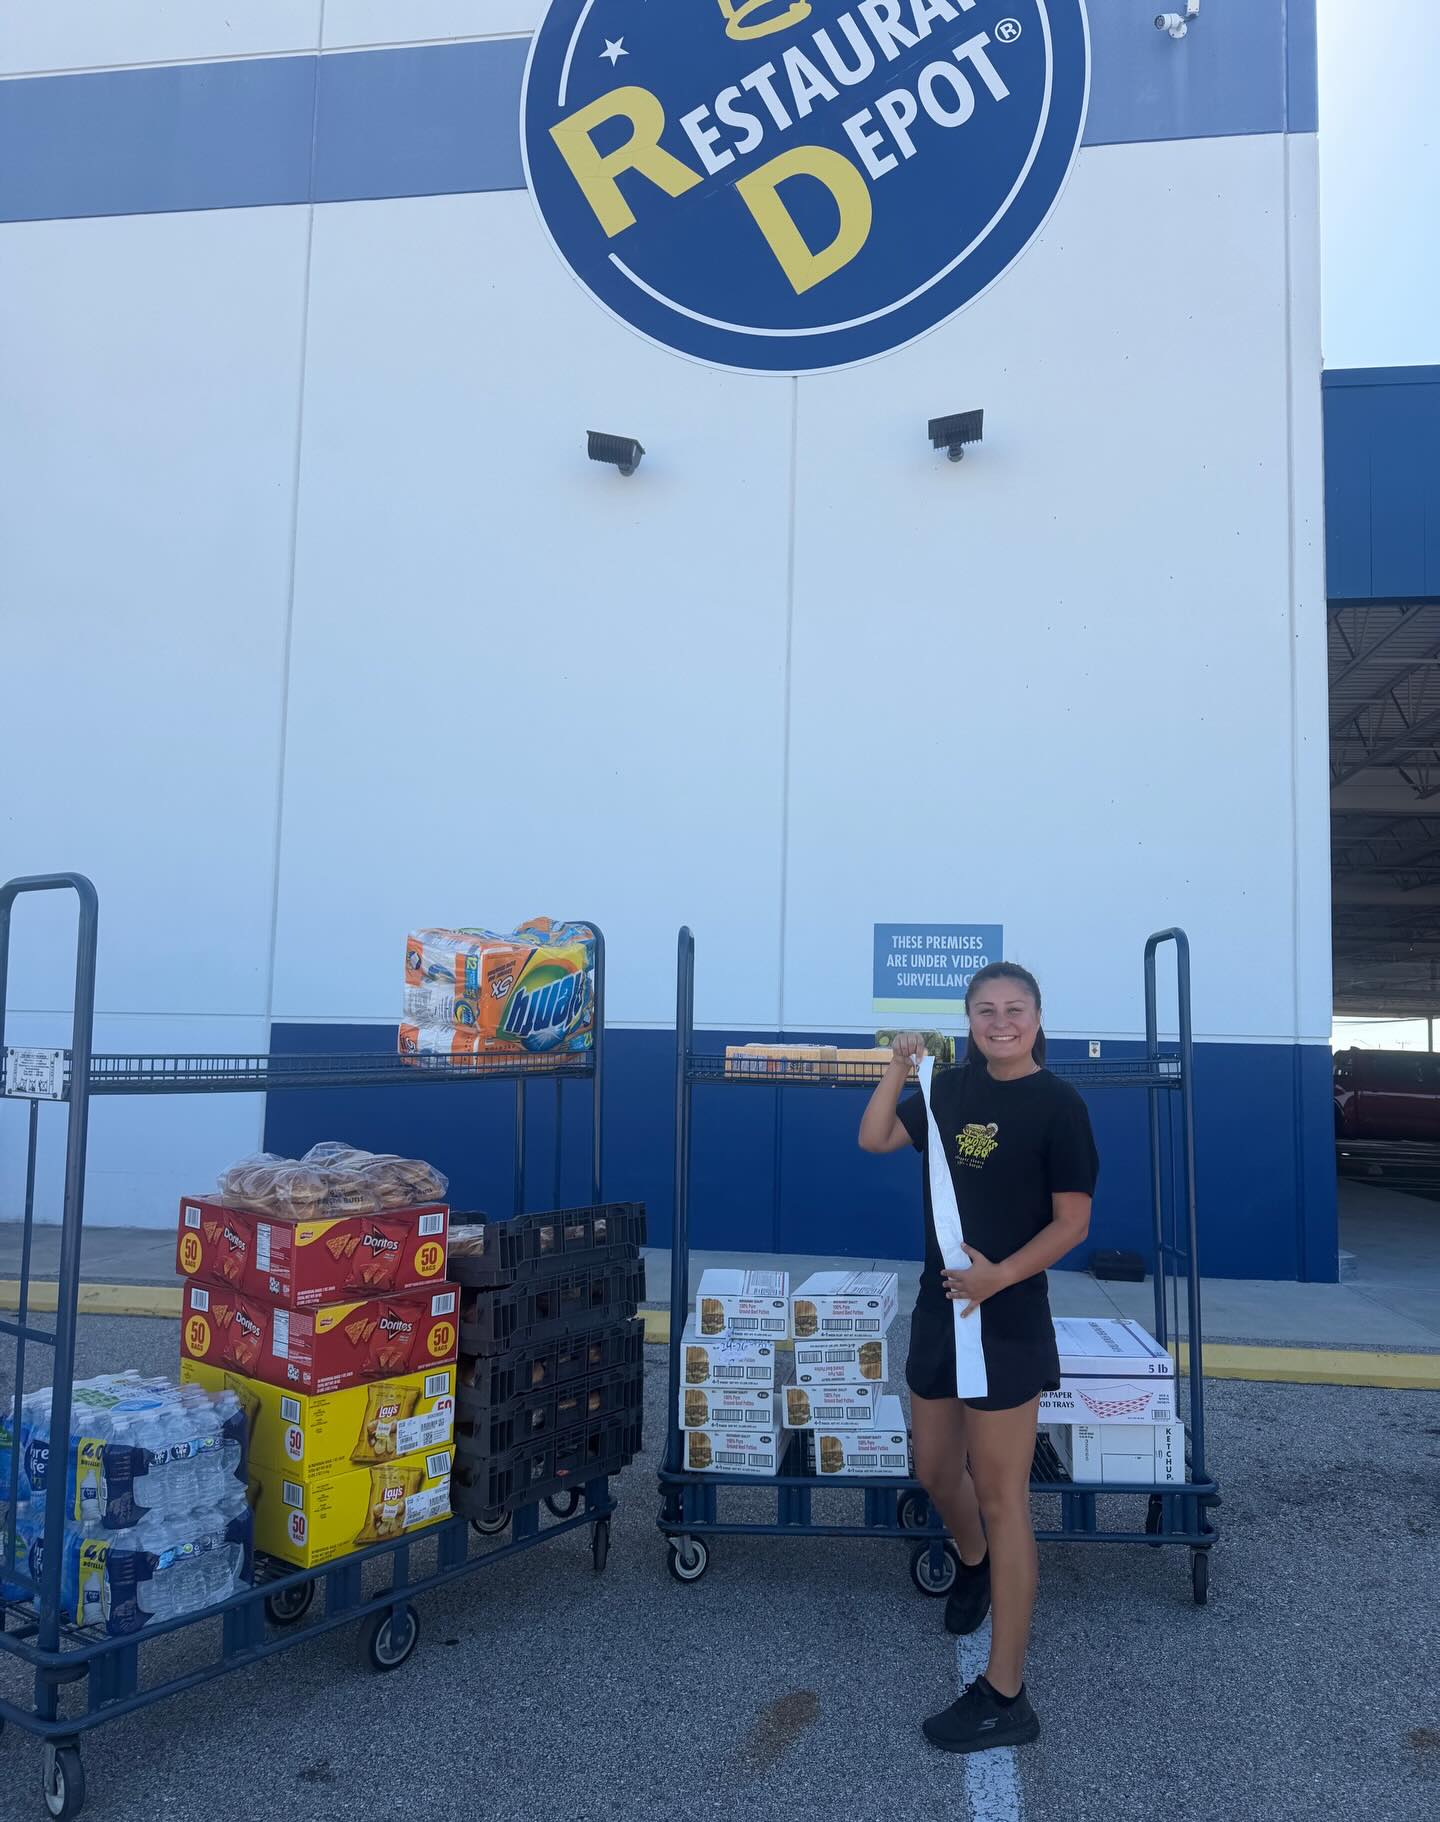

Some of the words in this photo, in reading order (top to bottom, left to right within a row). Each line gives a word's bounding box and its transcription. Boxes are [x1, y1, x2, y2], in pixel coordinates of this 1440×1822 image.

[892, 935, 923, 949] THESE
[926, 936, 984, 950] PREMISES
[886, 954, 908, 968] ARE
[910, 954, 948, 968] UNDER
[951, 955, 989, 969] VIDEO
[896, 972, 974, 987] SURVEILLANC
[223, 1226, 247, 1252] Doritos
[362, 1234, 400, 1251] Doritos
[184, 1238, 198, 1259] 50
[421, 1246, 438, 1265] 50
[421, 1264, 437, 1272] BAGS
[190, 1320, 206, 1343] 50
[235, 1311, 261, 1337] Doritos
[379, 1318, 413, 1333] Doritos
[433, 1326, 449, 1346] 50
[433, 1344, 449, 1352] BAGS
[1148, 1364, 1155, 1374] 5
[1157, 1363, 1169, 1374] lb
[1049, 1391, 1073, 1399] PAPER
[378, 1403, 399, 1418] Lay's
[289, 1430, 302, 1449] 50
[1165, 1427, 1173, 1481] KETCHUP
[383, 1486, 404, 1501] Lay's
[292, 1513, 305, 1535] 50
